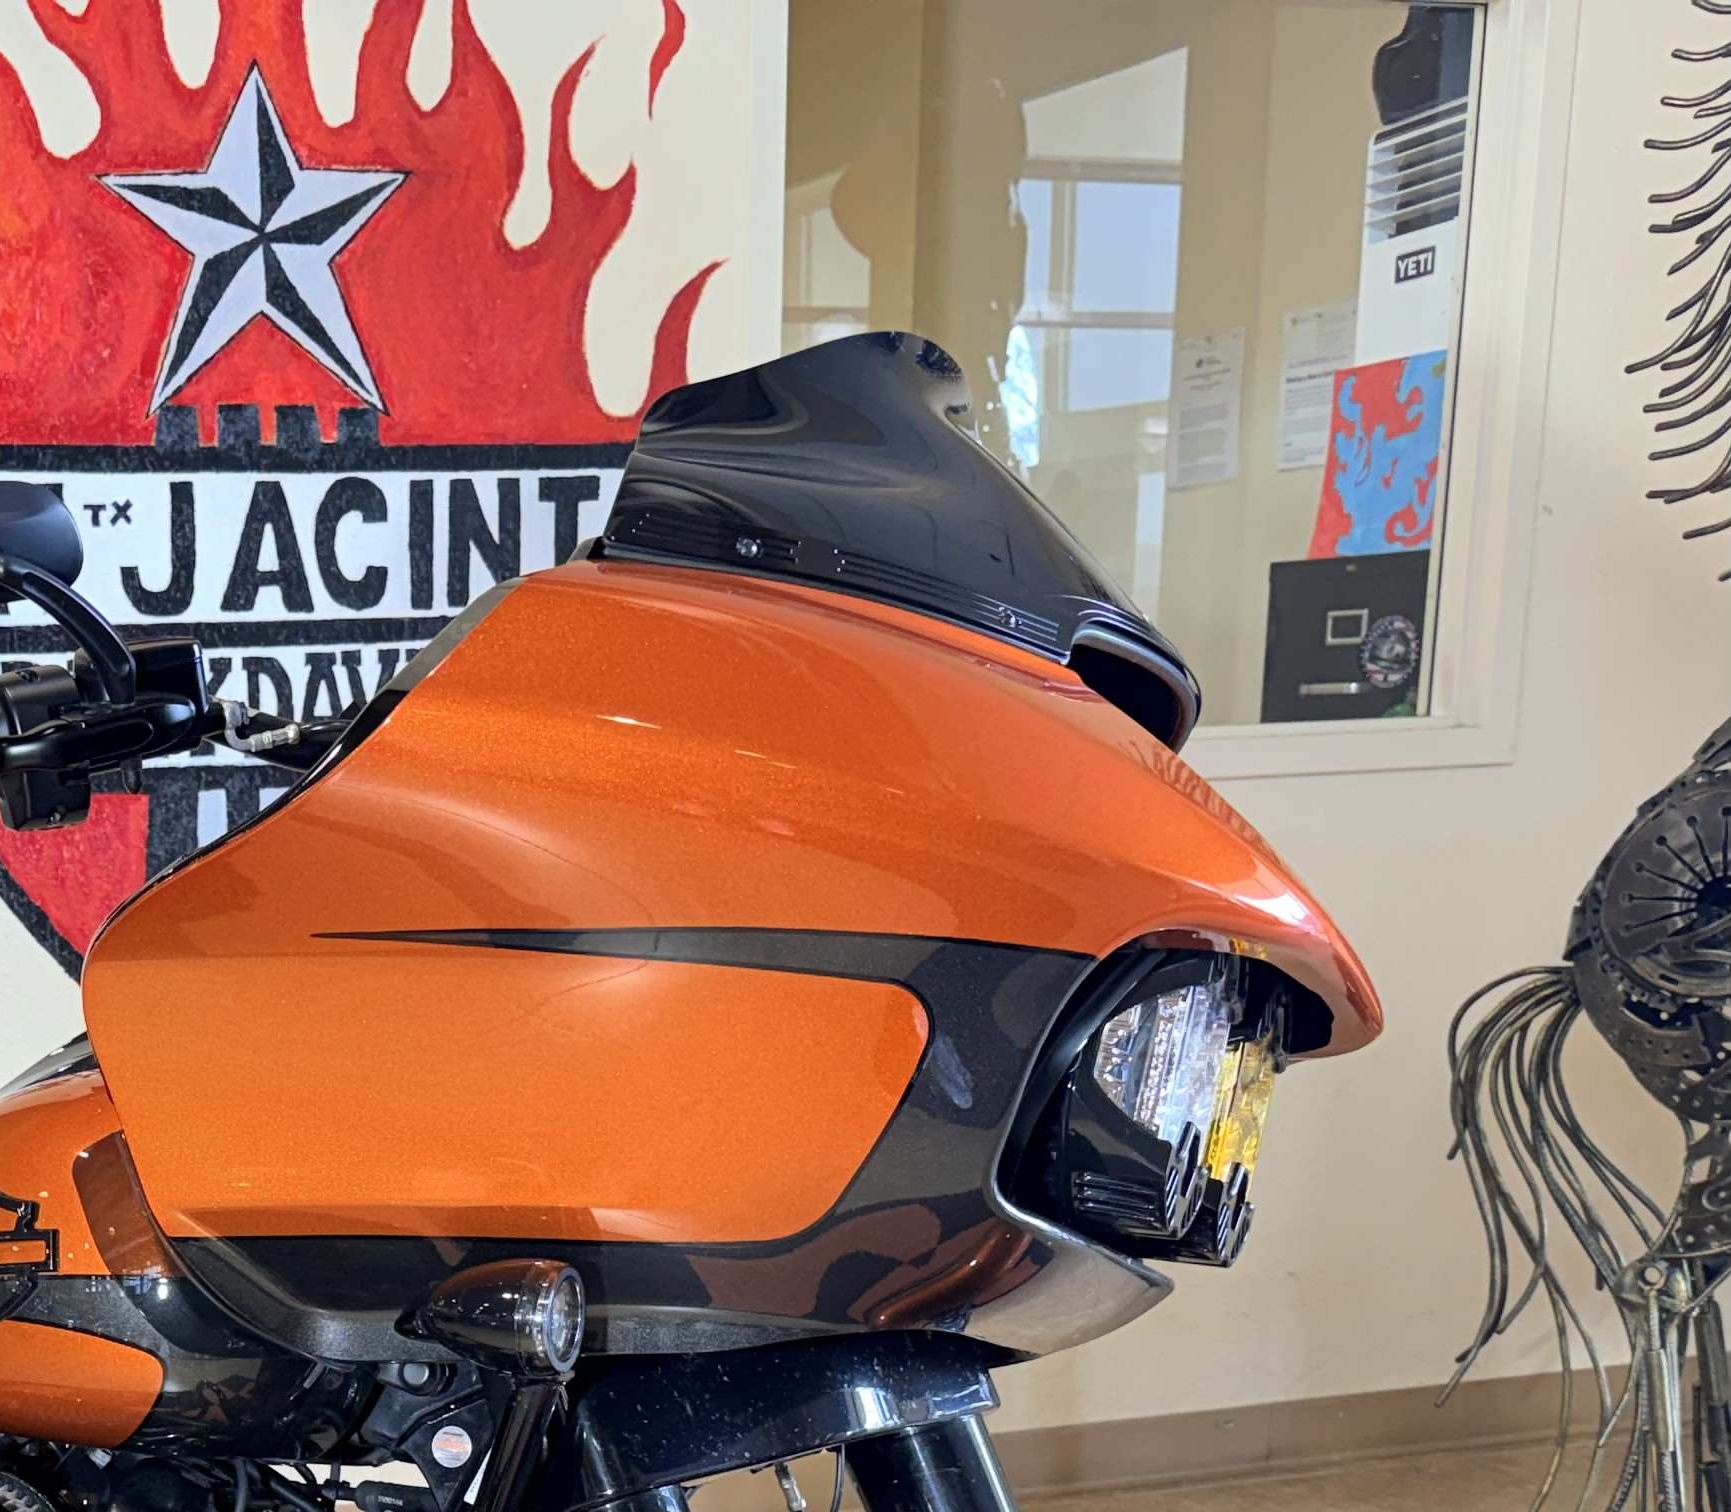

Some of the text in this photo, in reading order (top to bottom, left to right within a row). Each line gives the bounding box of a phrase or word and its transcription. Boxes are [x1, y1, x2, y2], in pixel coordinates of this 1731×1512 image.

[1397, 252, 1434, 279] YETI
[84, 499, 133, 528] TX
[120, 475, 602, 617] JACINT
